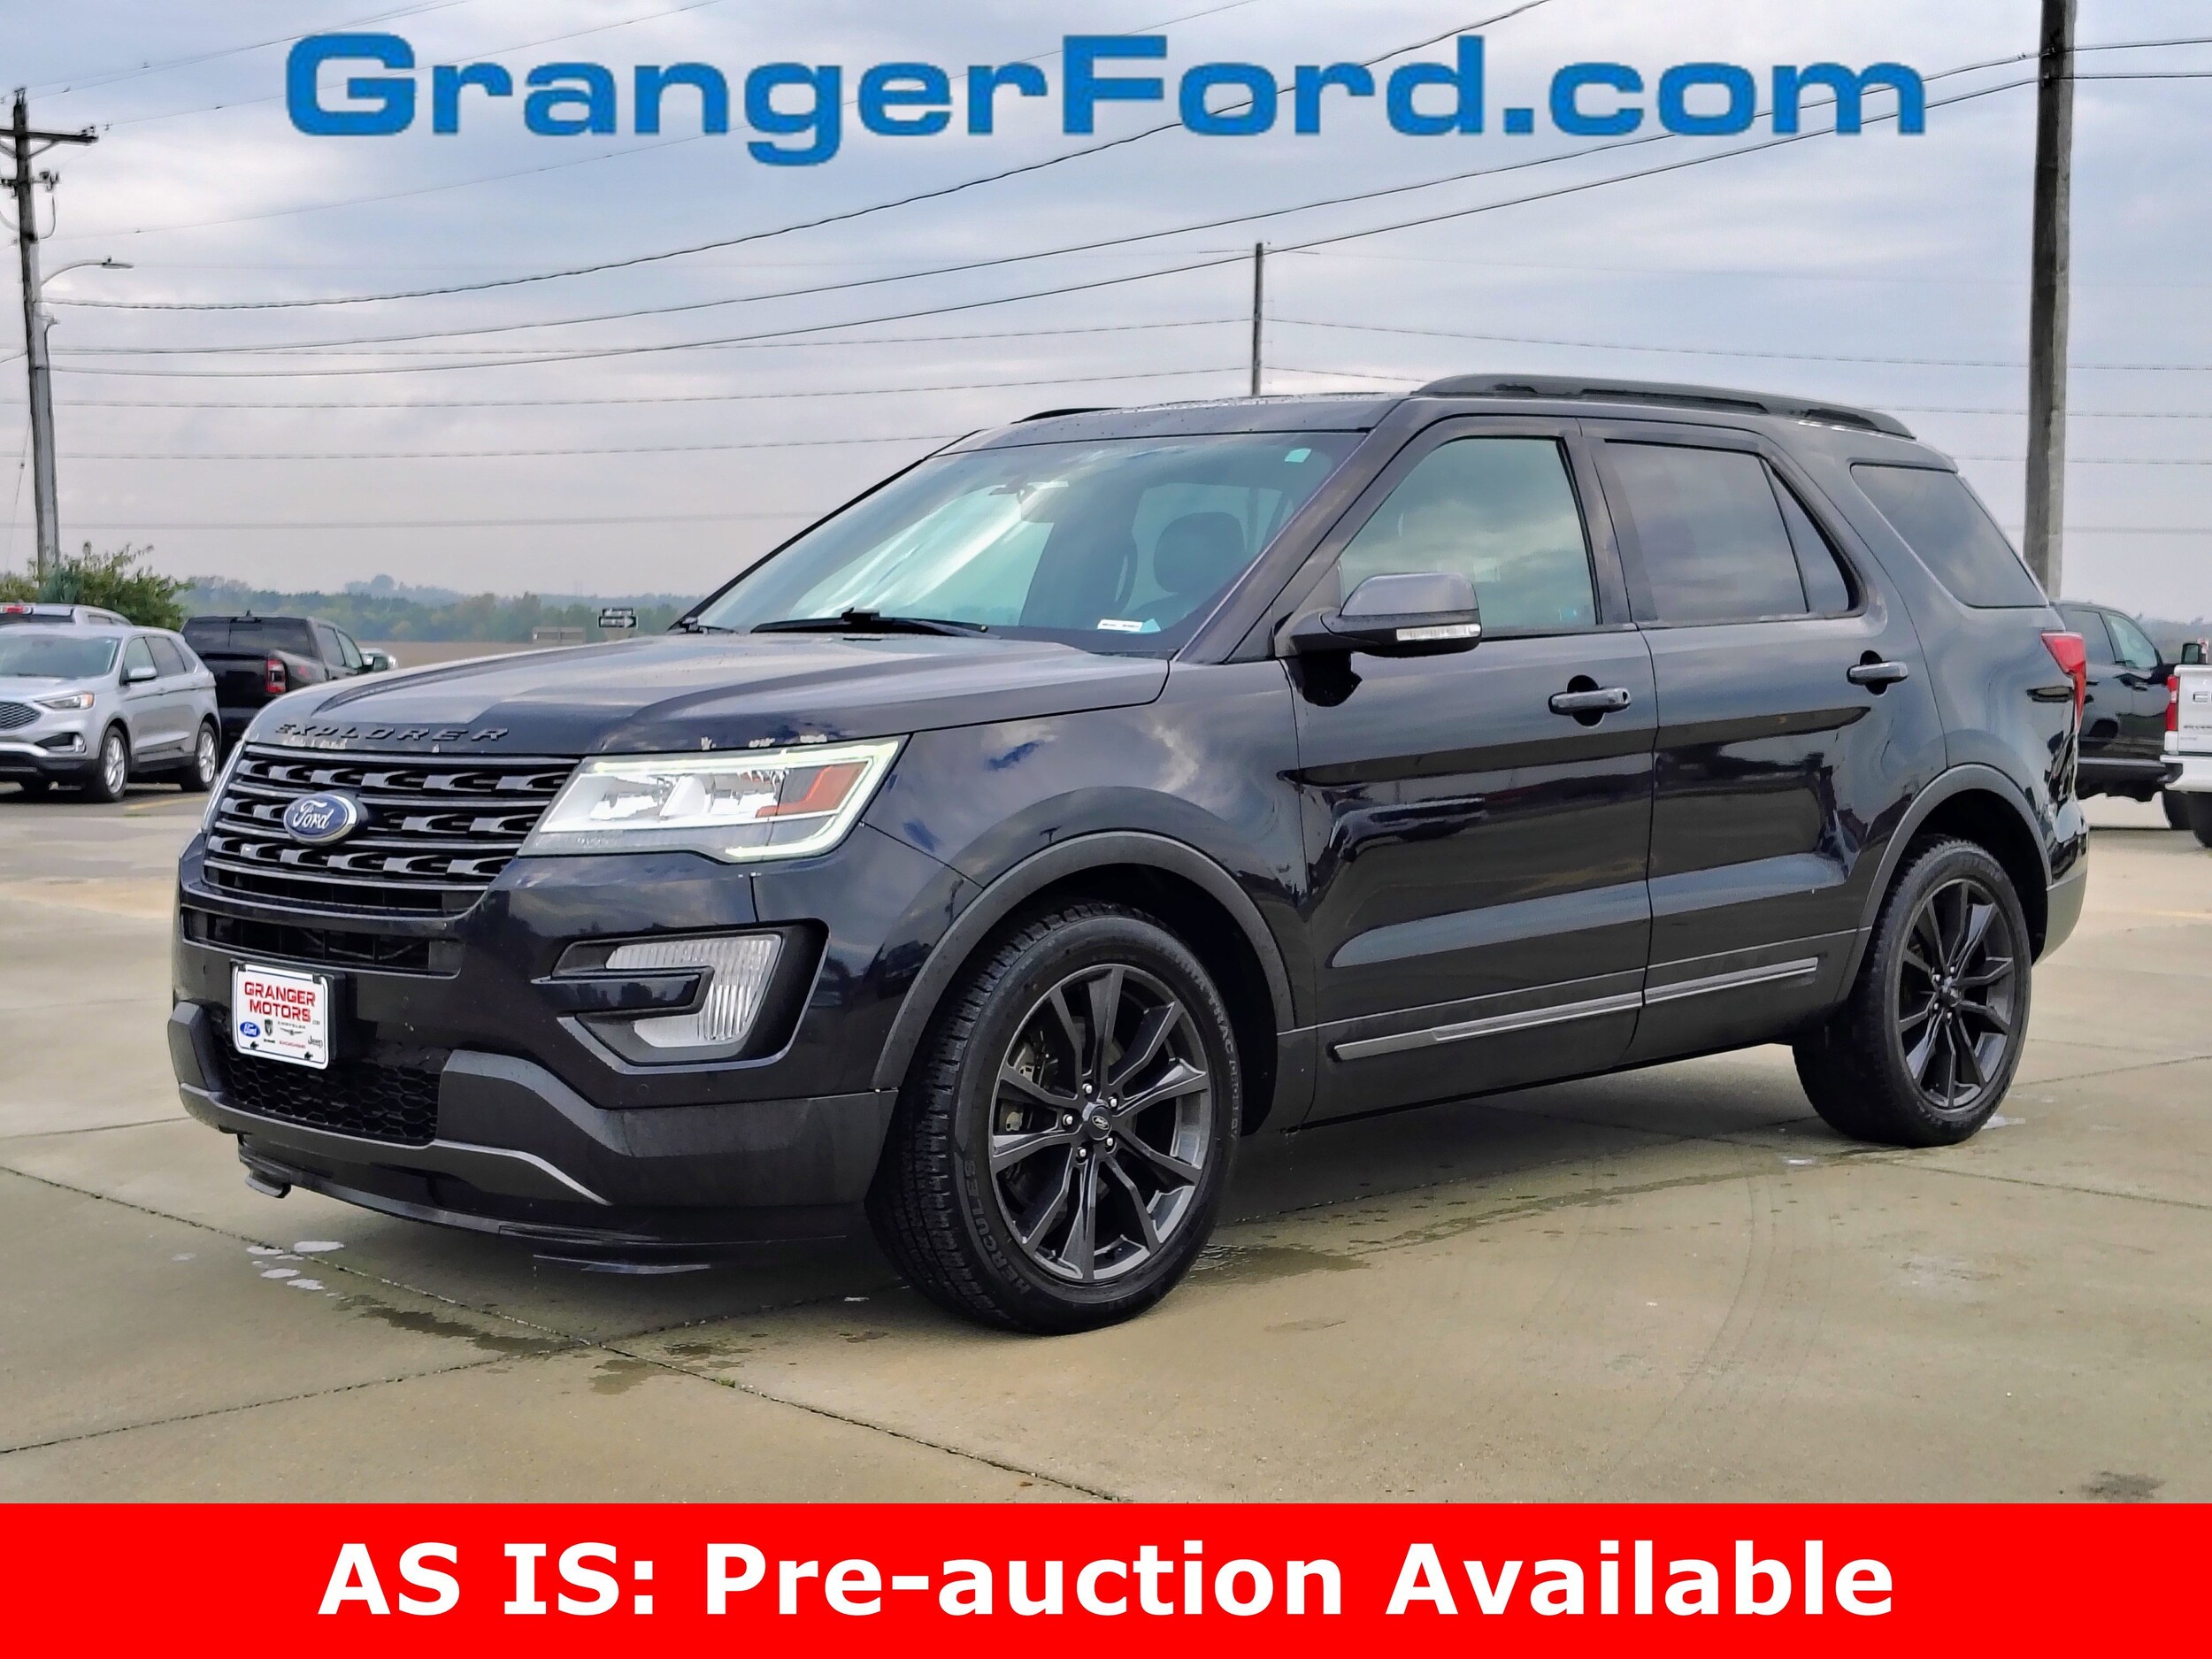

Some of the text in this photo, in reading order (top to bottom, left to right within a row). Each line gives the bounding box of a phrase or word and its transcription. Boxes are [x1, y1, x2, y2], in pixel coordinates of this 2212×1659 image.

[275, 722, 510, 742] EXPLORER
[292, 799, 334, 831] Ford
[244, 981, 316, 1007] GRANGER
[249, 999, 311, 1023] MOTORS
